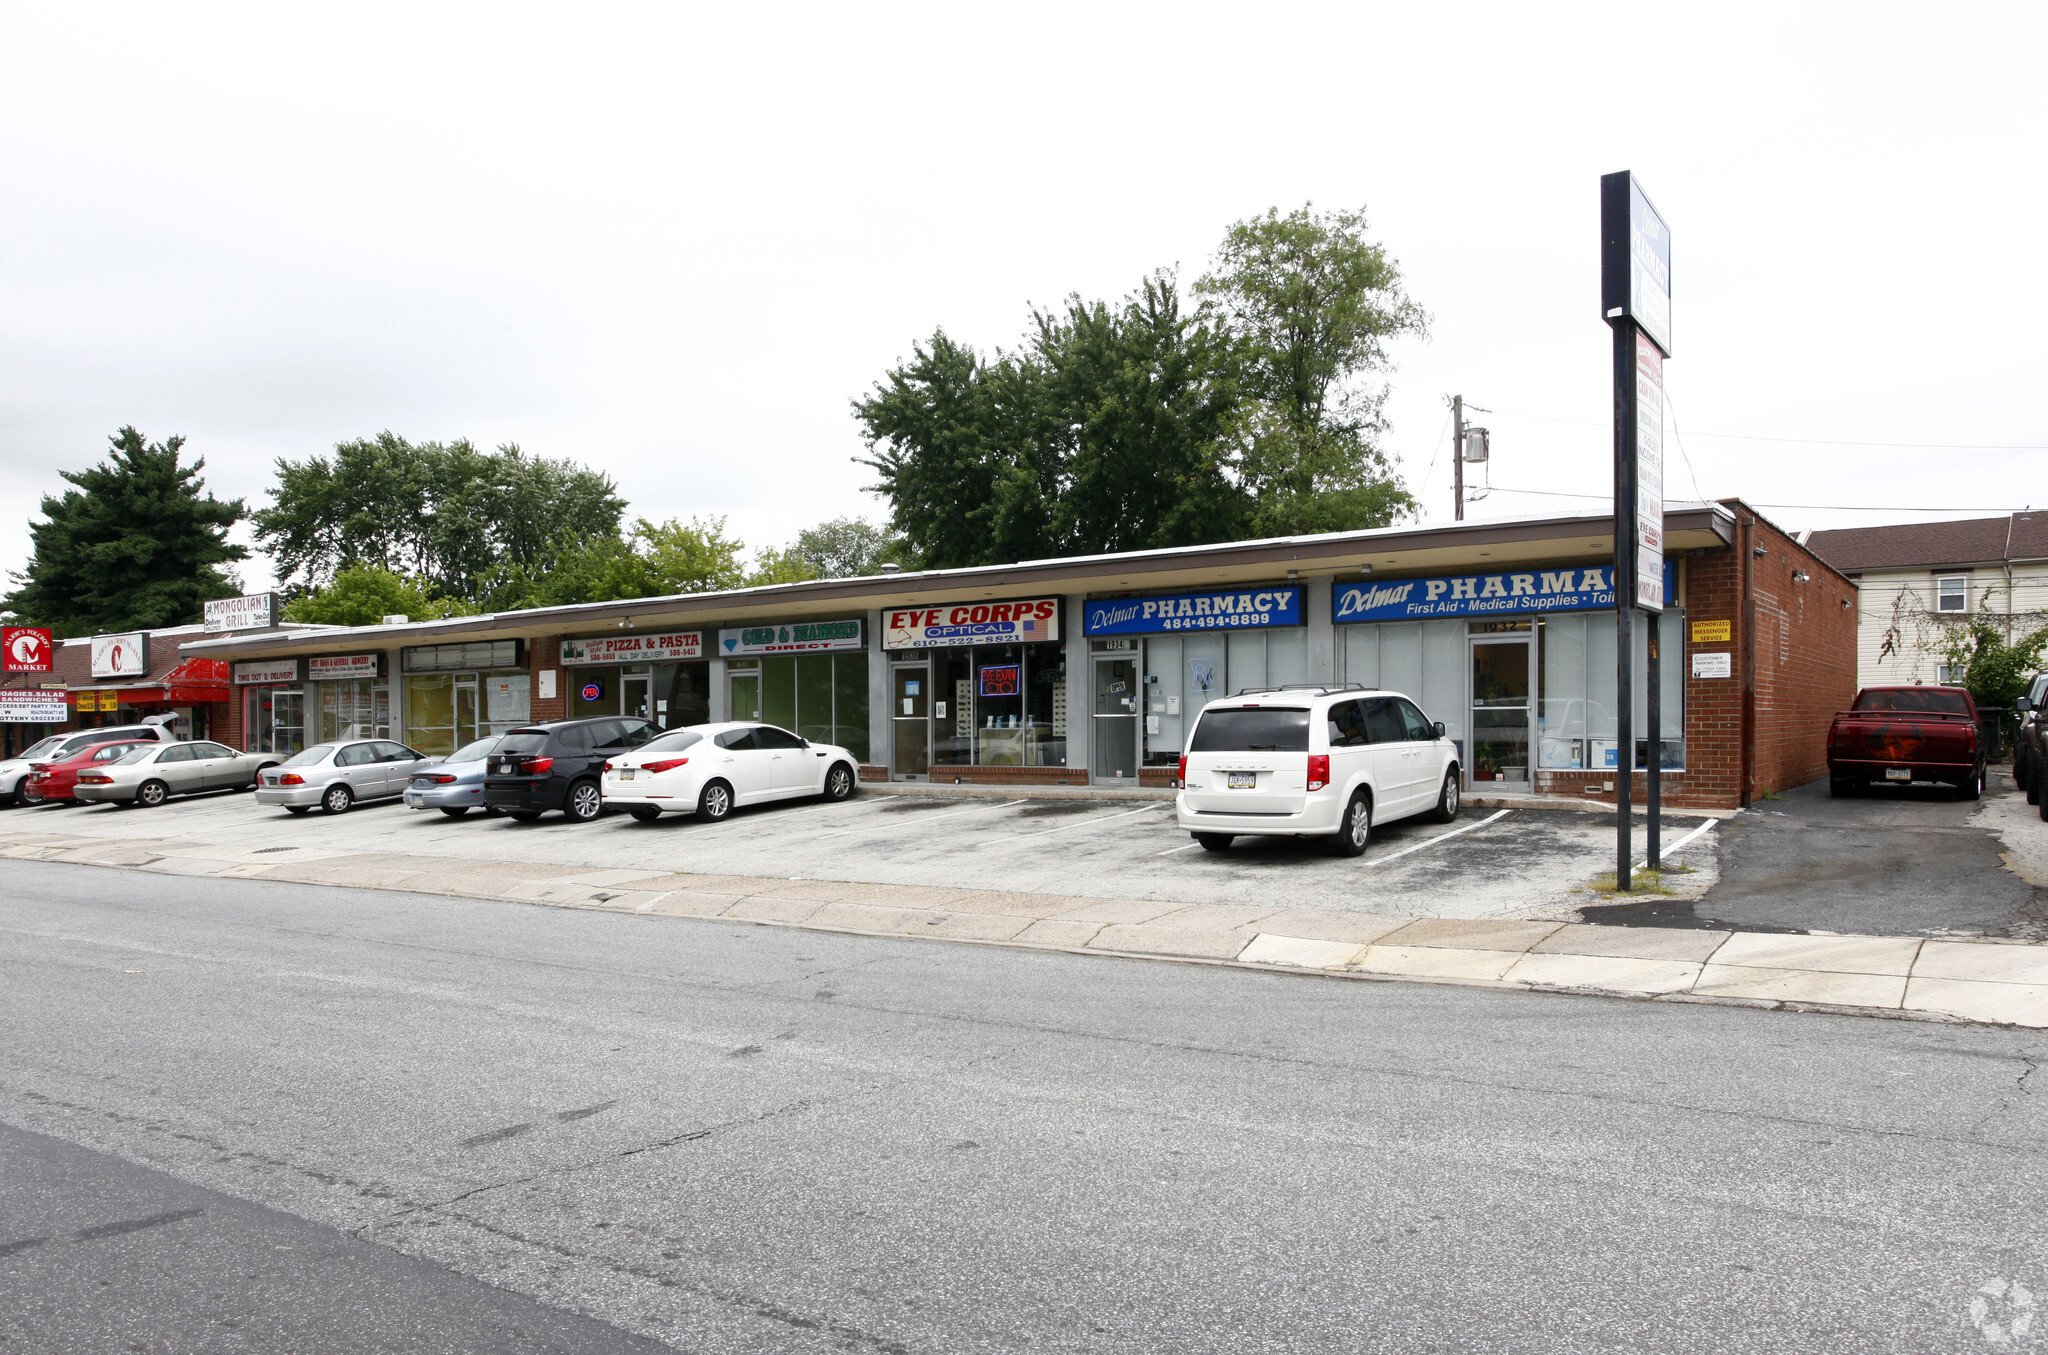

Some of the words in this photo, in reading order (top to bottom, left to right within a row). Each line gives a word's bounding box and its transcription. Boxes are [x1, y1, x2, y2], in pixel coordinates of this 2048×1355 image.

[1632, 221, 1669, 292] PHARMACY
[1640, 521, 1648, 535] EYE
[1425, 569, 1614, 601] PHARMA
[213, 596, 262, 615] MONGOLIAN
[1142, 591, 1293, 620] PHARMACY
[1337, 582, 1414, 618] Delmar
[1406, 602, 1434, 614] First
[1436, 600, 1457, 613] Aid
[1468, 598, 1518, 612] Medical
[1521, 594, 1578, 611] Supplies
[225, 613, 249, 627] GRILL
[890, 609, 943, 630] EYE
[950, 600, 1055, 626] CORPS
[1091, 604, 1140, 630] Delmar
[205, 618, 222, 627] Deliver
[1483, 620, 1517, 632] 1932
[742, 627, 775, 646] GOLD
[778, 626, 789, 643] &
[793, 621, 859, 642] DIAMOND
[927, 623, 1012, 637] OPTICAL
[585, 639, 604, 649] Italian
[606, 638, 642, 652] PIZZA
[646, 637, 656, 649] &
[659, 634, 700, 649] PASTA
[765, 642, 832, 651] DIRECT
[913, 634, 1022, 648] 610-522-8821
[1106, 640, 1124, 650] 1934
[589, 646, 602, 654] Style
[590, 652, 616, 661] 586-5555
[618, 652, 628, 660] ALL
[630, 651, 641, 660] DAY
[641, 650, 665, 659] DELIVERY
[669, 648, 696, 657] 586-5411
[238, 673, 250, 682] TAKE
[251, 673, 262, 681] OUT
[270, 671, 294, 680] DELIVERY
[981, 669, 997, 683] EYE
[583, 687, 598, 698] OPEN
[1110, 681, 1126, 693] OPEN
